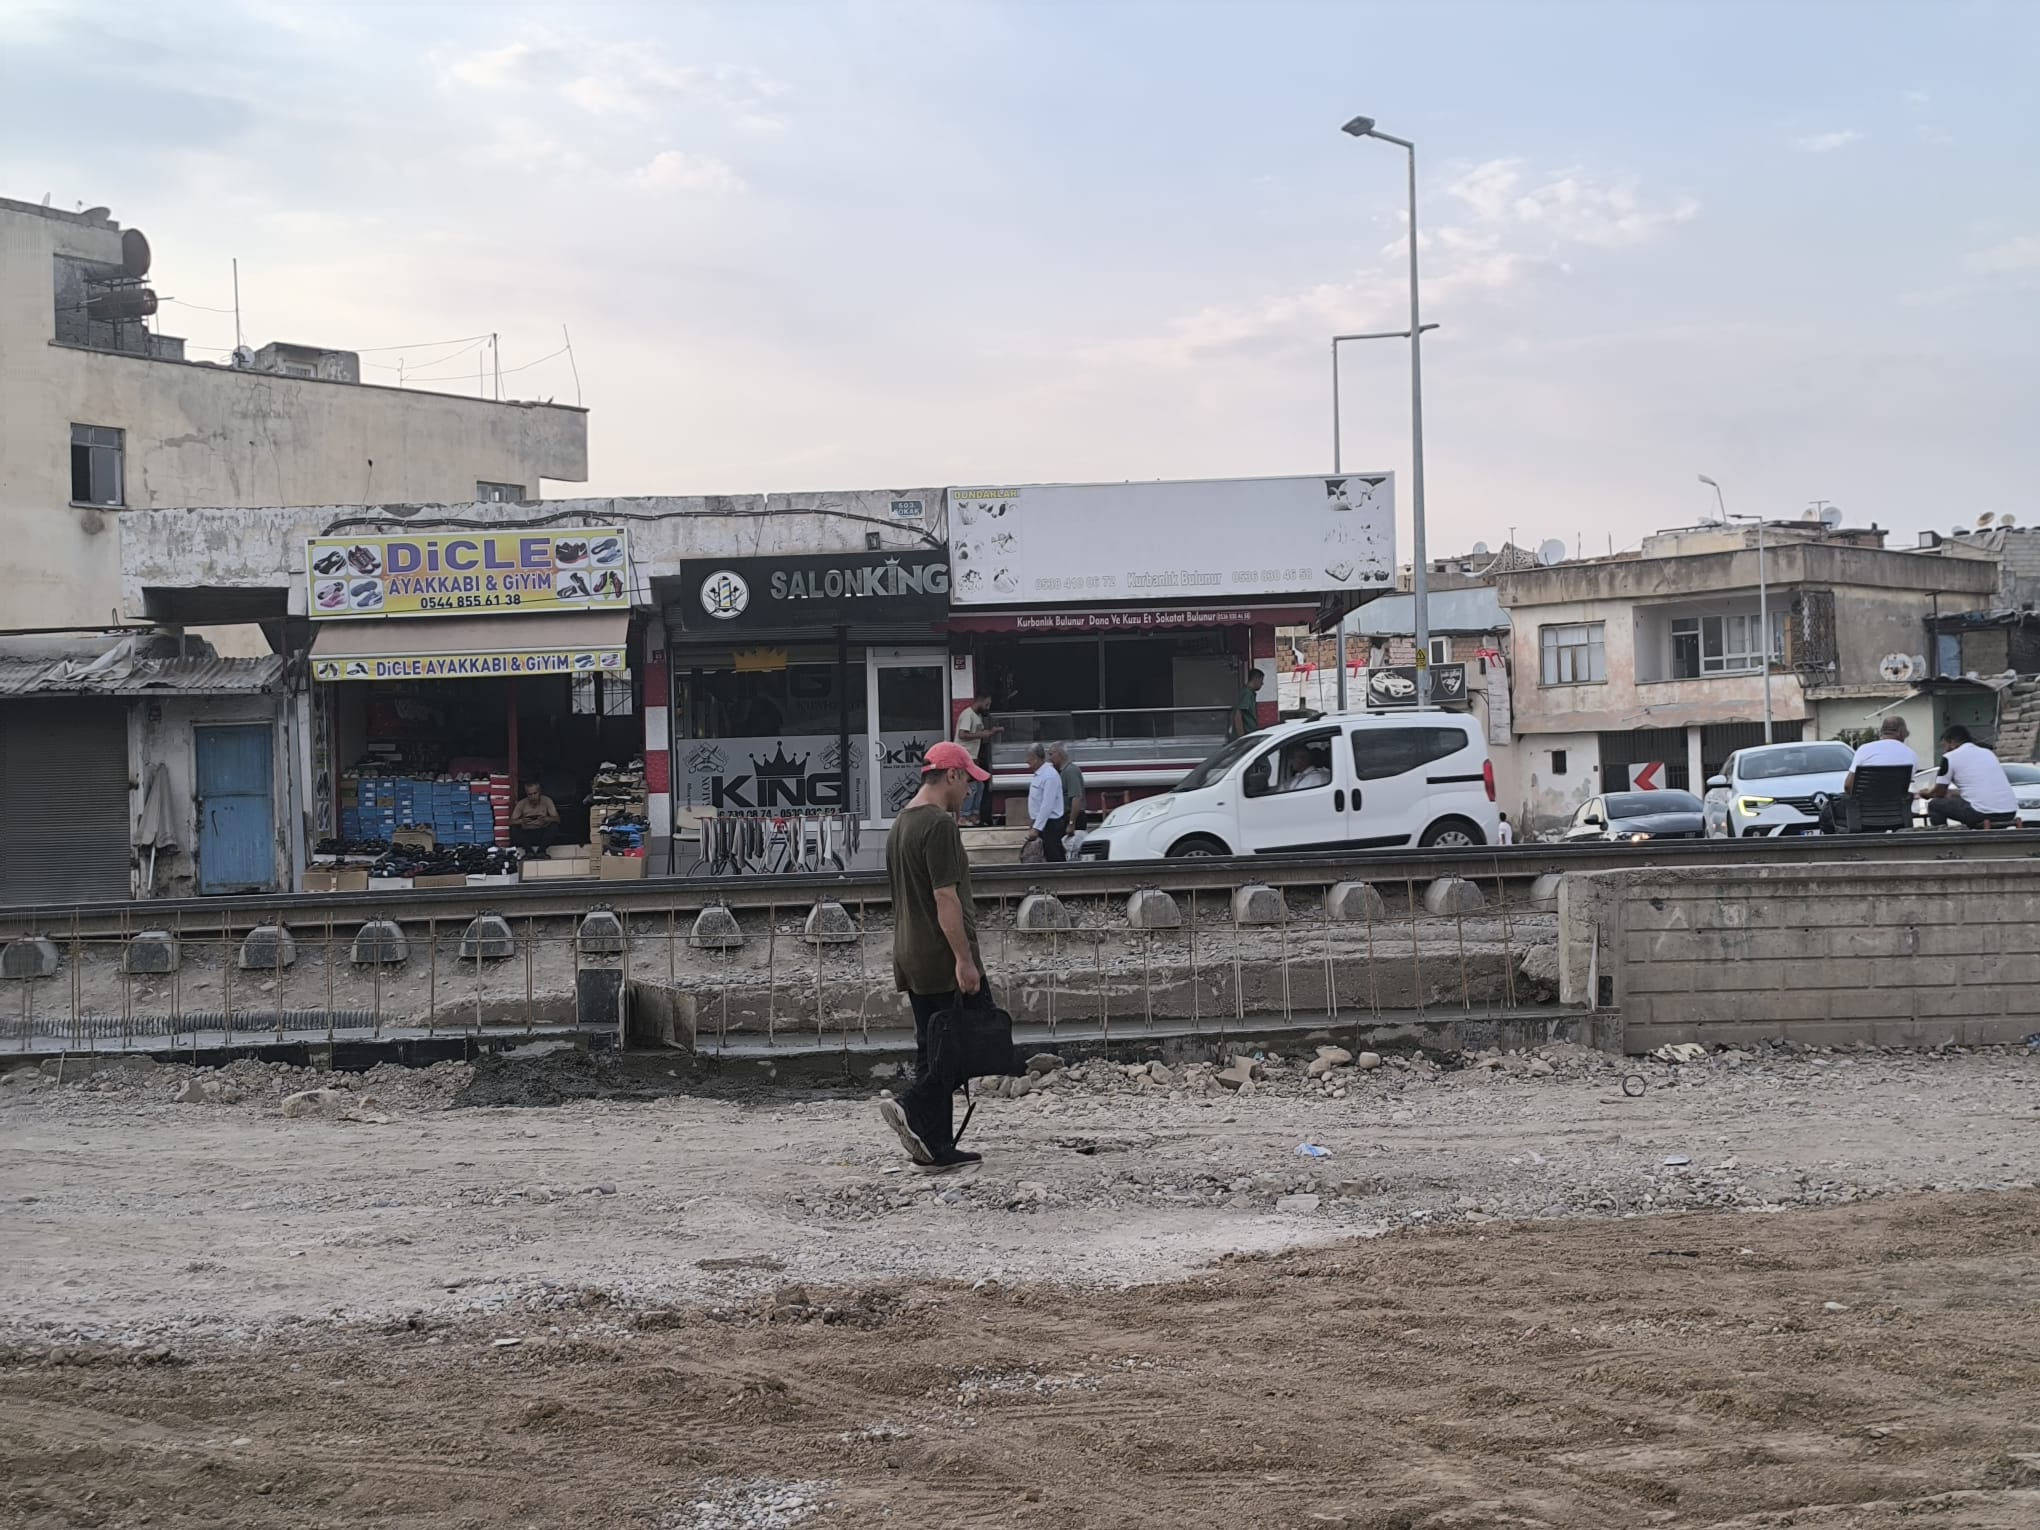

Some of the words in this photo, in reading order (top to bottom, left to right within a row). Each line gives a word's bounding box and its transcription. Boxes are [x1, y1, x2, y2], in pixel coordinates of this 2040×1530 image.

[389, 576, 480, 595] AYAKKABI
[485, 575, 498, 590] &
[421, 596, 453, 609] 0544
[457, 595, 481, 607] 855
[485, 595, 500, 606] 61
[505, 594, 521, 605] 38
[1056, 615, 1085, 626] Bulunur
[1089, 615, 1109, 625] Dana
[1111, 614, 1121, 624] Ve
[1122, 613, 1142, 624] Kuzu
[1143, 613, 1152, 624] Et
[1155, 612, 1185, 623] Sakatat
[1186, 610, 1216, 622] Bulunur
[426, 657, 507, 675] AYAKKABI
[510, 656, 521, 671] &
[886, 749, 927, 764] KIN
[711, 773, 842, 809] KING
